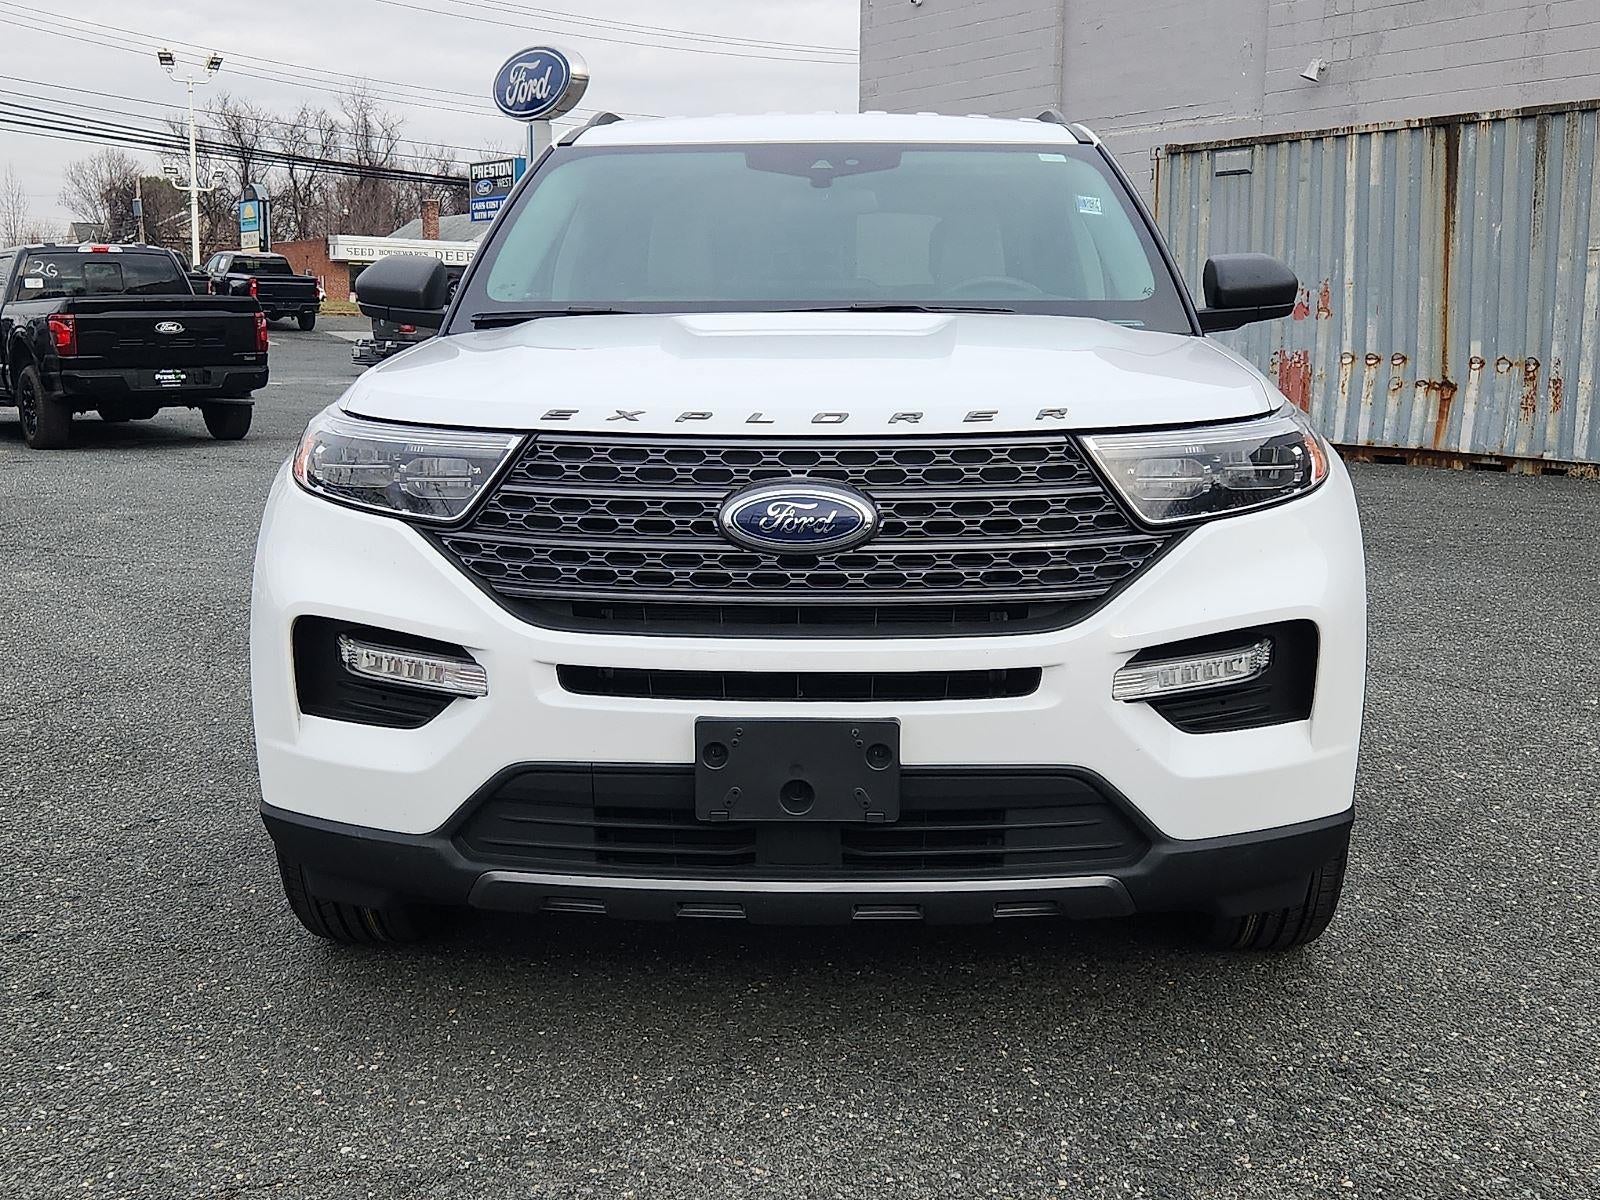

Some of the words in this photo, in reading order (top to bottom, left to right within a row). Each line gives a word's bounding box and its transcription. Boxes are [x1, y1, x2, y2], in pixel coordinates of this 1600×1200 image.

[505, 59, 553, 107] Ford
[471, 161, 512, 180] PRESTON
[496, 177, 512, 188] WEST
[346, 247, 375, 257] SEED
[159, 322, 178, 332] Ford
[540, 407, 1068, 424] EXPLORER
[759, 501, 838, 534] Ford
